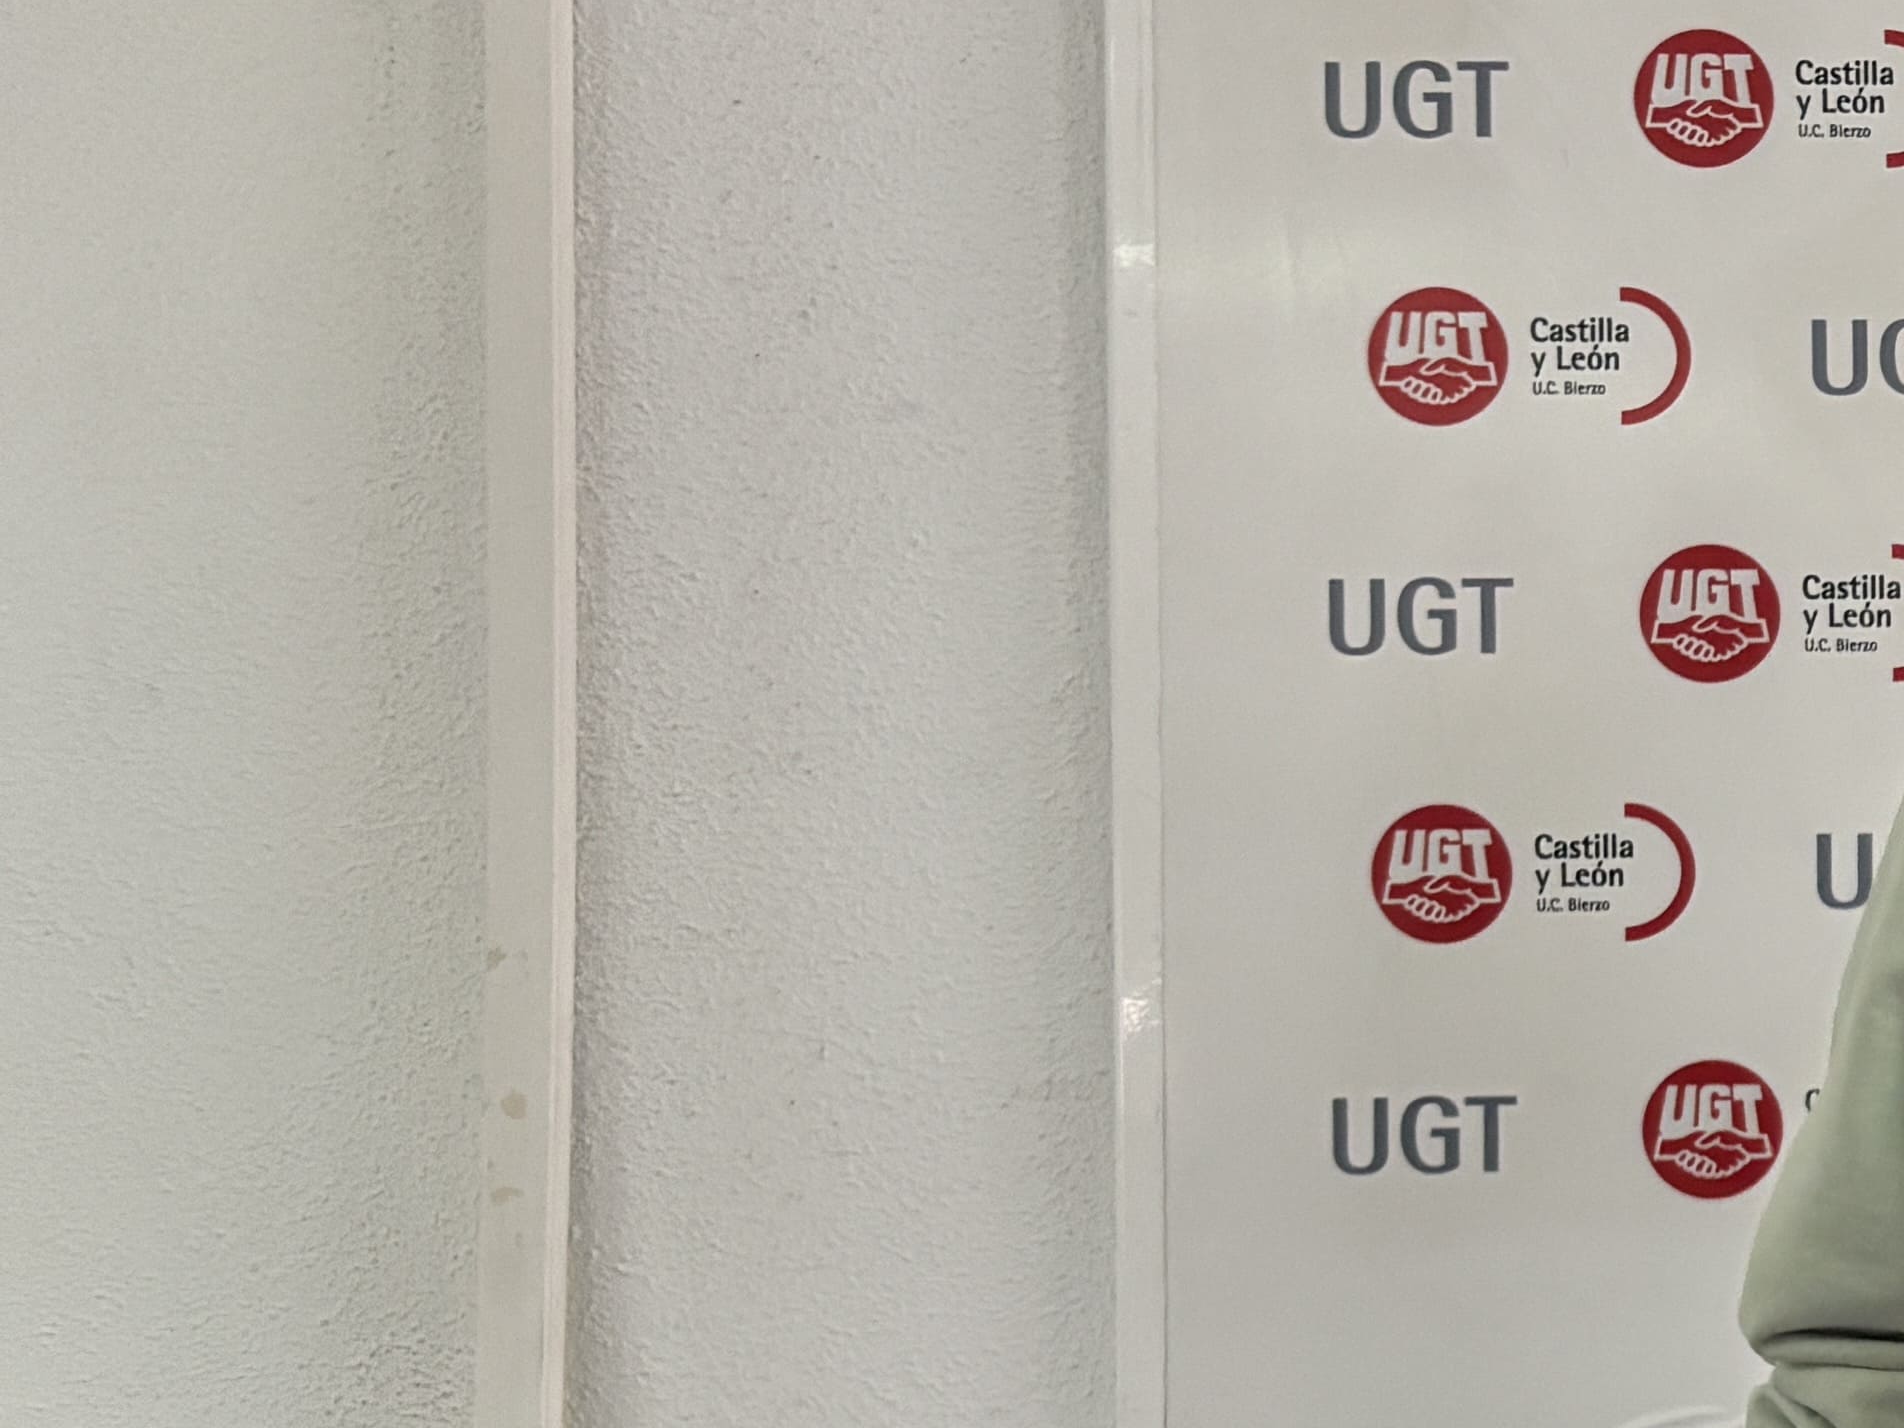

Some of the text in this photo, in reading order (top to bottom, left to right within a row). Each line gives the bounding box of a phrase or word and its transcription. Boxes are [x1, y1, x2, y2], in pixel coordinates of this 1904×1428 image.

[1652, 54, 1755, 105] UGT
[1795, 60, 1894, 86] Castilla
[1325, 60, 1509, 138] UGT
[1796, 87, 1884, 120] y León
[1798, 124, 1871, 138] U.C. Bierzo
[1386, 312, 1488, 362] UGT
[1530, 317, 1629, 343] Castilla
[1531, 344, 1619, 377] y León
[1533, 381, 1605, 395] U.C. Bierzo
[1658, 569, 1760, 620] UGT
[1802, 574, 1901, 600] Castilla
[1329, 577, 1513, 655] UGT
[1803, 601, 1891, 635] y León
[1805, 638, 1877, 652] U.C. Bierzo
[1389, 829, 1492, 880] UGT
[1534, 833, 1633, 860] Castilla
[1535, 860, 1624, 895] y León
[1536, 898, 1610, 912] U.C. Bierzo
[1660, 1085, 1763, 1136] UGT
[1332, 1096, 1517, 1175] UGT
